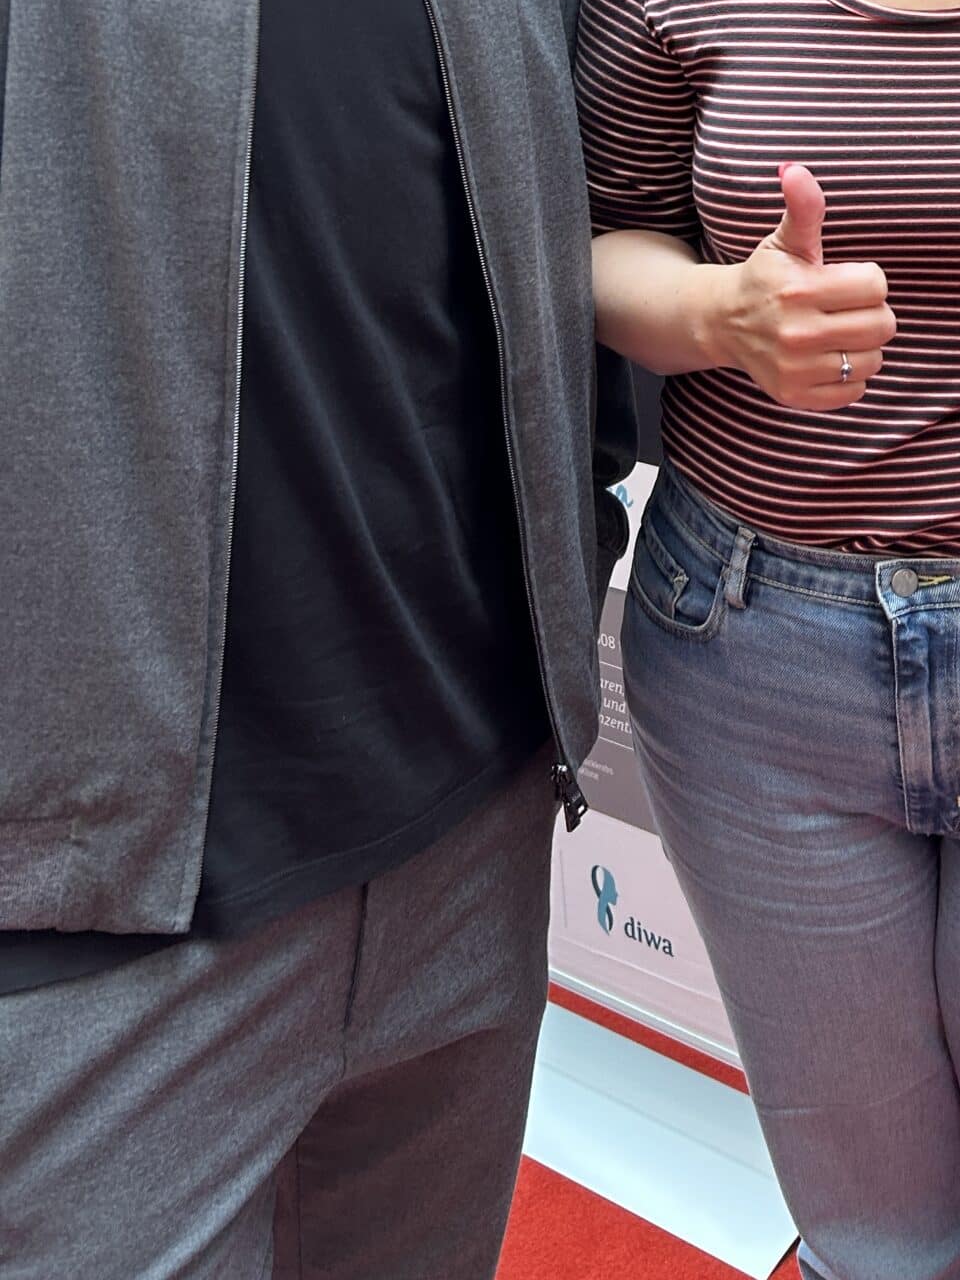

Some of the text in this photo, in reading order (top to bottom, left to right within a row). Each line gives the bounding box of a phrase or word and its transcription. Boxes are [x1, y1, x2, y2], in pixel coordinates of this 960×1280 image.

[597, 633, 616, 649] 08
[603, 696, 626, 714] und
[623, 915, 675, 958] diwa
